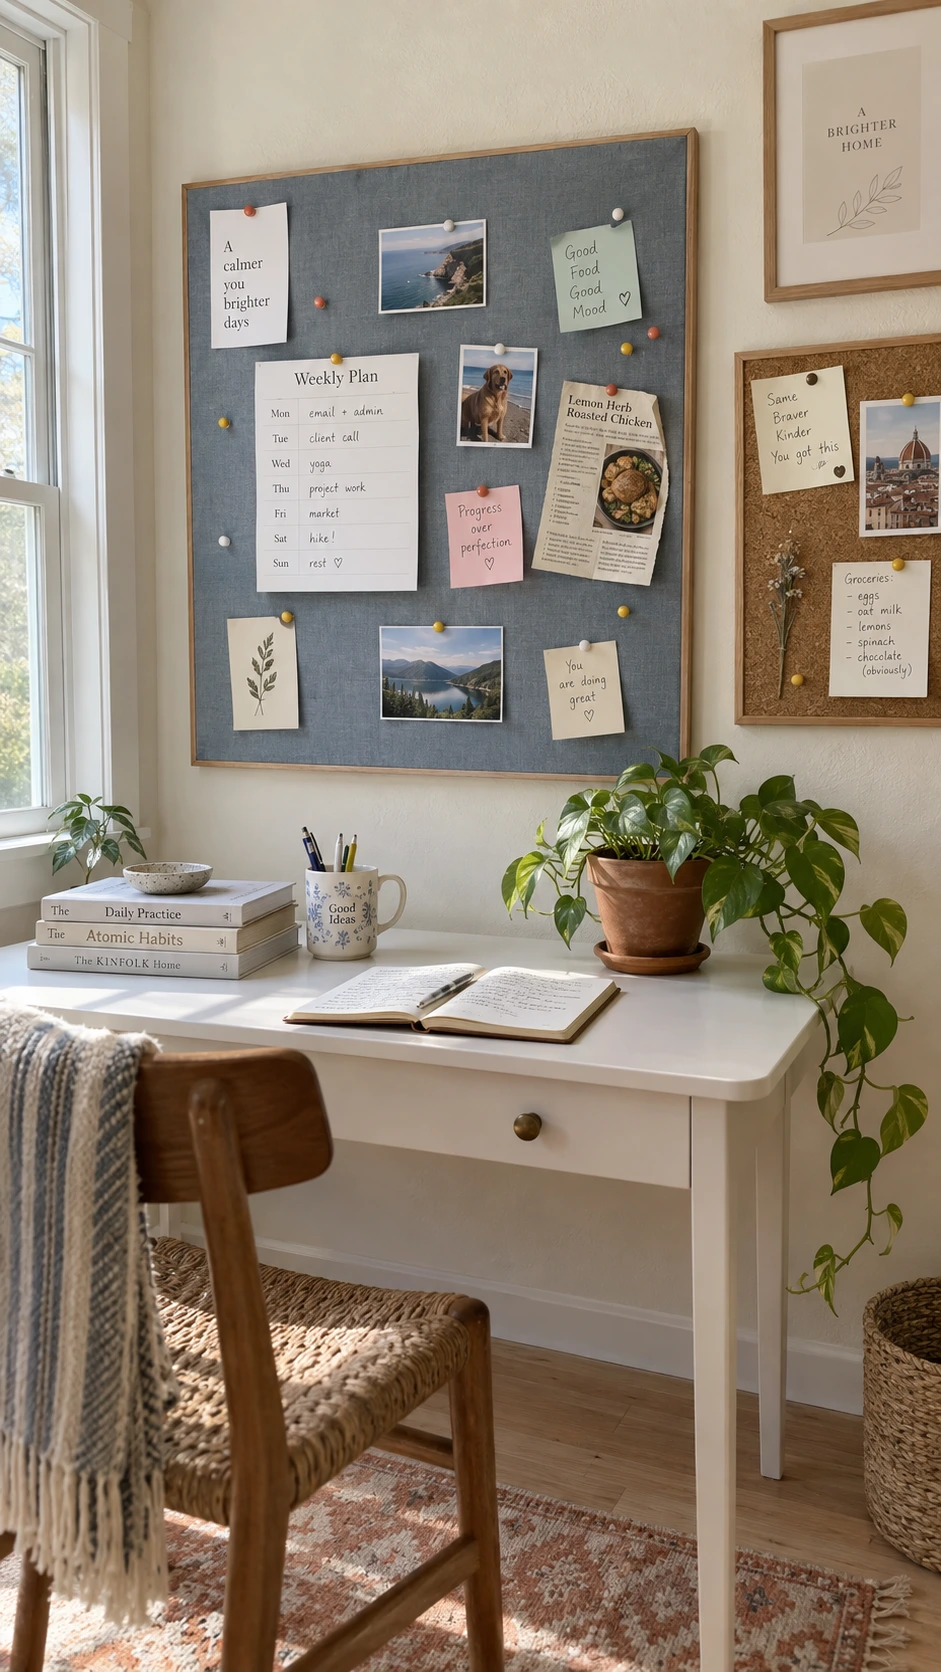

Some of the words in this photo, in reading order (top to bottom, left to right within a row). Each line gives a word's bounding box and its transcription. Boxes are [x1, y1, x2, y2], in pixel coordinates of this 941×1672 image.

[857, 107, 866, 117] A
[827, 118, 897, 138] BRIGHTER
[842, 137, 882, 152] HOME
[223, 240, 233, 252] A
[565, 240, 598, 261] Good
[223, 258, 263, 271] calmer
[570, 260, 600, 279] Food
[223, 280, 245, 294] you
[569, 280, 603, 300] Good
[223, 295, 270, 312] brighter
[573, 299, 607, 319] Mood
[223, 315, 249, 331] days
[294, 371, 344, 388] Weekly
[349, 369, 378, 384] Plan
[568, 395, 603, 409] Lemon
[606, 400, 632, 413] Herb
[767, 392, 798, 406] Same
[271, 409, 290, 418] Mon
[309, 406, 335, 418] email
[354, 405, 384, 417] admin
[567, 407, 608, 422] Roasted
[610, 413, 653, 428] Chicken
[773, 410, 809, 424] Braver
[272, 434, 289, 443] Tue
[309, 432, 336, 443] client
[342, 431, 359, 442] call
[776, 426, 812, 442] Kinder
[770, 450, 790, 464] You
[796, 444, 812, 465] got
[818, 441, 840, 454] this
[271, 459, 291, 468] Wed
[309, 460, 332, 474] yoga
[272, 484, 290, 494] Thu
[309, 482, 339, 498] project
[345, 482, 366, 493] work
[274, 509, 287, 518] Fri
[309, 508, 340, 518] market
[458, 503, 502, 521] Progress
[471, 523, 493, 535] over
[274, 534, 287, 543] Sat
[460, 537, 513, 557] perfection
[273, 558, 289, 568] Sun
[309, 558, 327, 568] rest
[844, 572, 894, 585] Groceries:
[858, 592, 880, 606] eggs
[858, 605, 874, 616] oat
[880, 604, 903, 615] milk
[858, 621, 892, 631] lemons
[858, 636, 895, 650] spinach
[857, 650, 902, 662] chocolate
[565, 659, 583, 674] You
[862, 663, 913, 679] (obviously)
[559, 679, 575, 689] are
[581, 675, 606, 690] doing
[569, 691, 596, 710] great
[51, 905, 70, 916] The
[105, 906, 134, 921] Daily
[137, 907, 182, 919] Practice
[328, 902, 356, 913] Good
[329, 914, 356, 924] Ideas
[86, 929, 135, 944] Atomic
[139, 931, 184, 947] Habits
[74, 955, 93, 965] The
[96, 956, 150, 968] KINFOLK
[153, 960, 181, 970] Home
